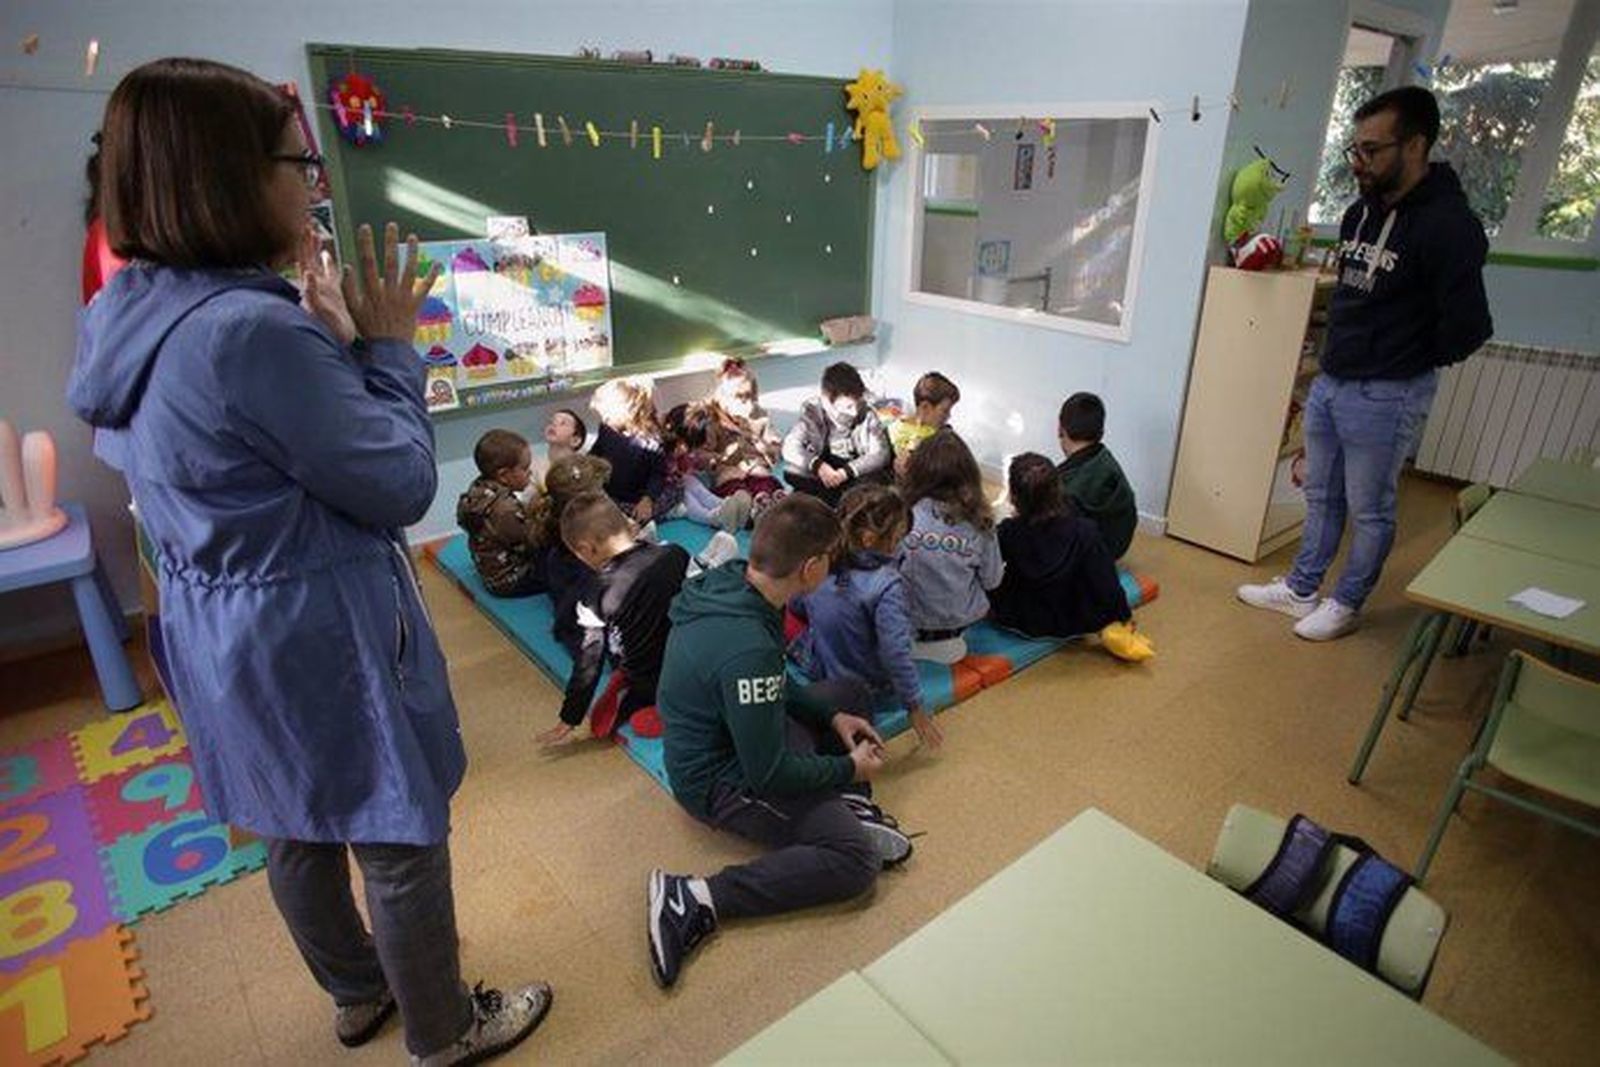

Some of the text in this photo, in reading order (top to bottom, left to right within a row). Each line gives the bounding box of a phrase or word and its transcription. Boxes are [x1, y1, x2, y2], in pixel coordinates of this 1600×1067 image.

[110, 713, 178, 757] 4
[121, 762, 194, 810] 9
[0, 813, 56, 872] 2
[143, 818, 230, 886] 6
[0, 880, 78, 960] 8
